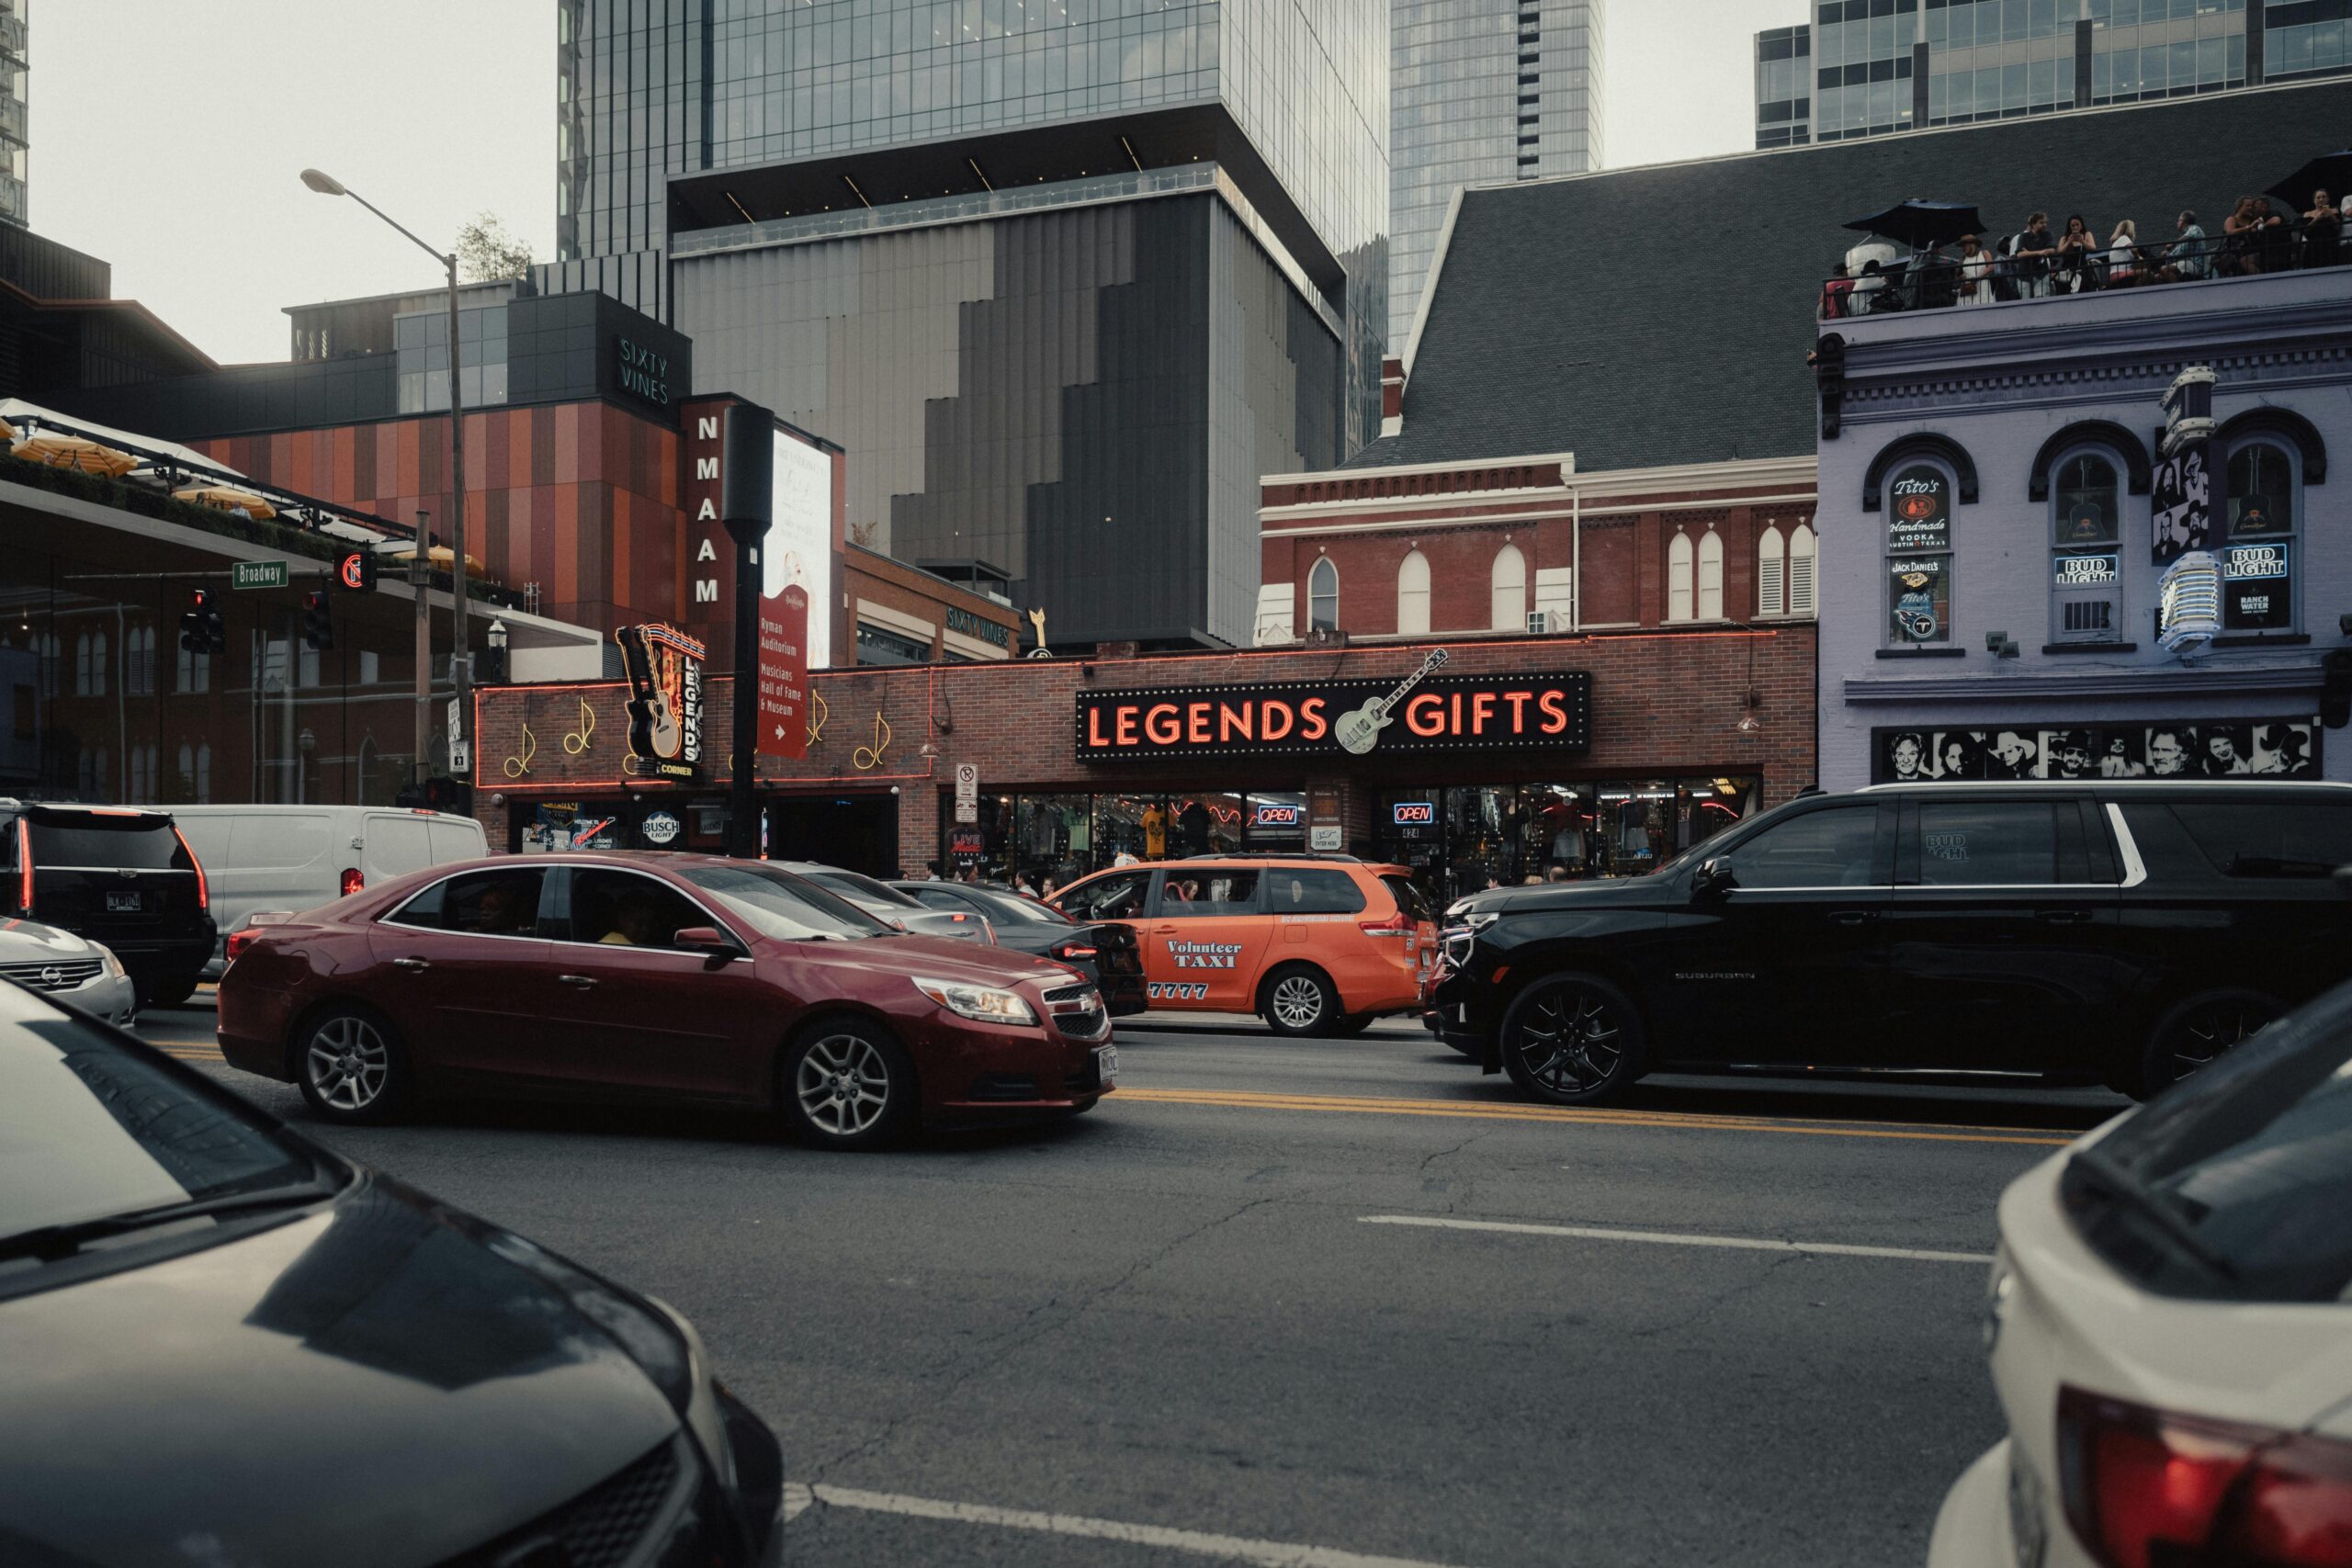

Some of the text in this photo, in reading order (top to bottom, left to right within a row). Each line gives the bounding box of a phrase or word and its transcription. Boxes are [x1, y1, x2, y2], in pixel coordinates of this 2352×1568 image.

[620, 338, 668, 378] SIXTY
[621, 367, 669, 404] VINES
[1894, 479, 1939, 495] Tito's
[1889, 518, 1946, 533] Handmade
[1899, 534, 1934, 542] VODKA
[2232, 547, 2276, 563] BUD
[1892, 561, 1939, 572] JACK DANIEL'S
[2065, 558, 2107, 574] BUD
[239, 564, 281, 585] Broadway
[1902, 592, 1929, 604] Tito's
[2240, 596, 2268, 604] RANCH
[2240, 603, 2268, 611] WATER
[761, 617, 783, 636] Ryman
[948, 607, 1009, 648] SIXTY VINES
[761, 637, 797, 658] Auditorium
[761, 663, 793, 682] Musicians
[761, 681, 802, 702] Hall of Fame
[684, 656, 697, 763] LEGENDS
[767, 701, 793, 717] Museum
[1089, 690, 1567, 748] LEGENDS GIFTS
[661, 763, 693, 776] CORNER
[1260, 808, 1295, 822] OPEN
[1396, 807, 1430, 821] OPEN
[643, 821, 680, 834] BUSCH
[1402, 828, 1419, 838] 424
[953, 833, 981, 845] LIVE
[1167, 941, 1242, 953] Volunteer
[1173, 955, 1236, 968] TAXI
[1148, 981, 1209, 999] 7777
